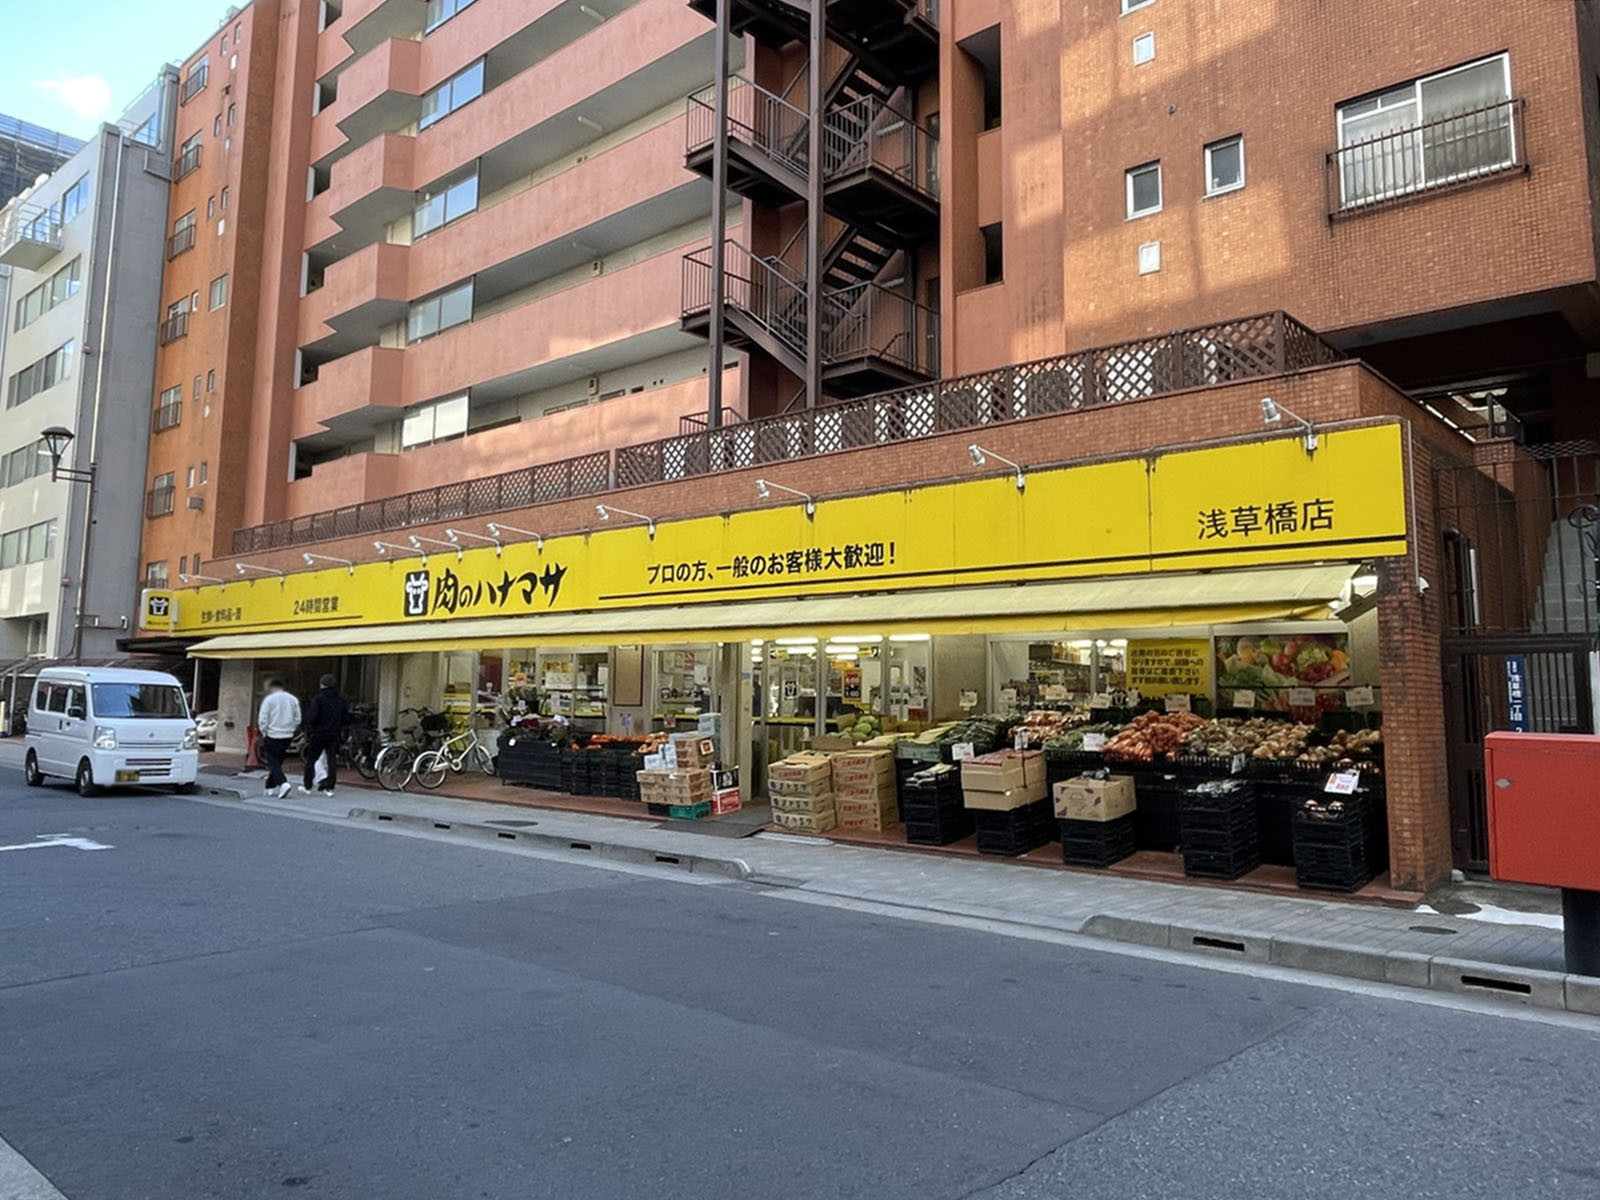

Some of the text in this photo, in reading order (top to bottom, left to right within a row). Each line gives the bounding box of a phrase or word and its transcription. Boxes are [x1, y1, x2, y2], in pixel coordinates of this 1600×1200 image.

[1198, 498, 1334, 540] 浅草橋店
[647, 542, 896, 584] プロの方、一般のお客様大歓迎！
[293, 596, 339, 616] 24時間営業
[432, 563, 568, 615] 肉のハナマサ
